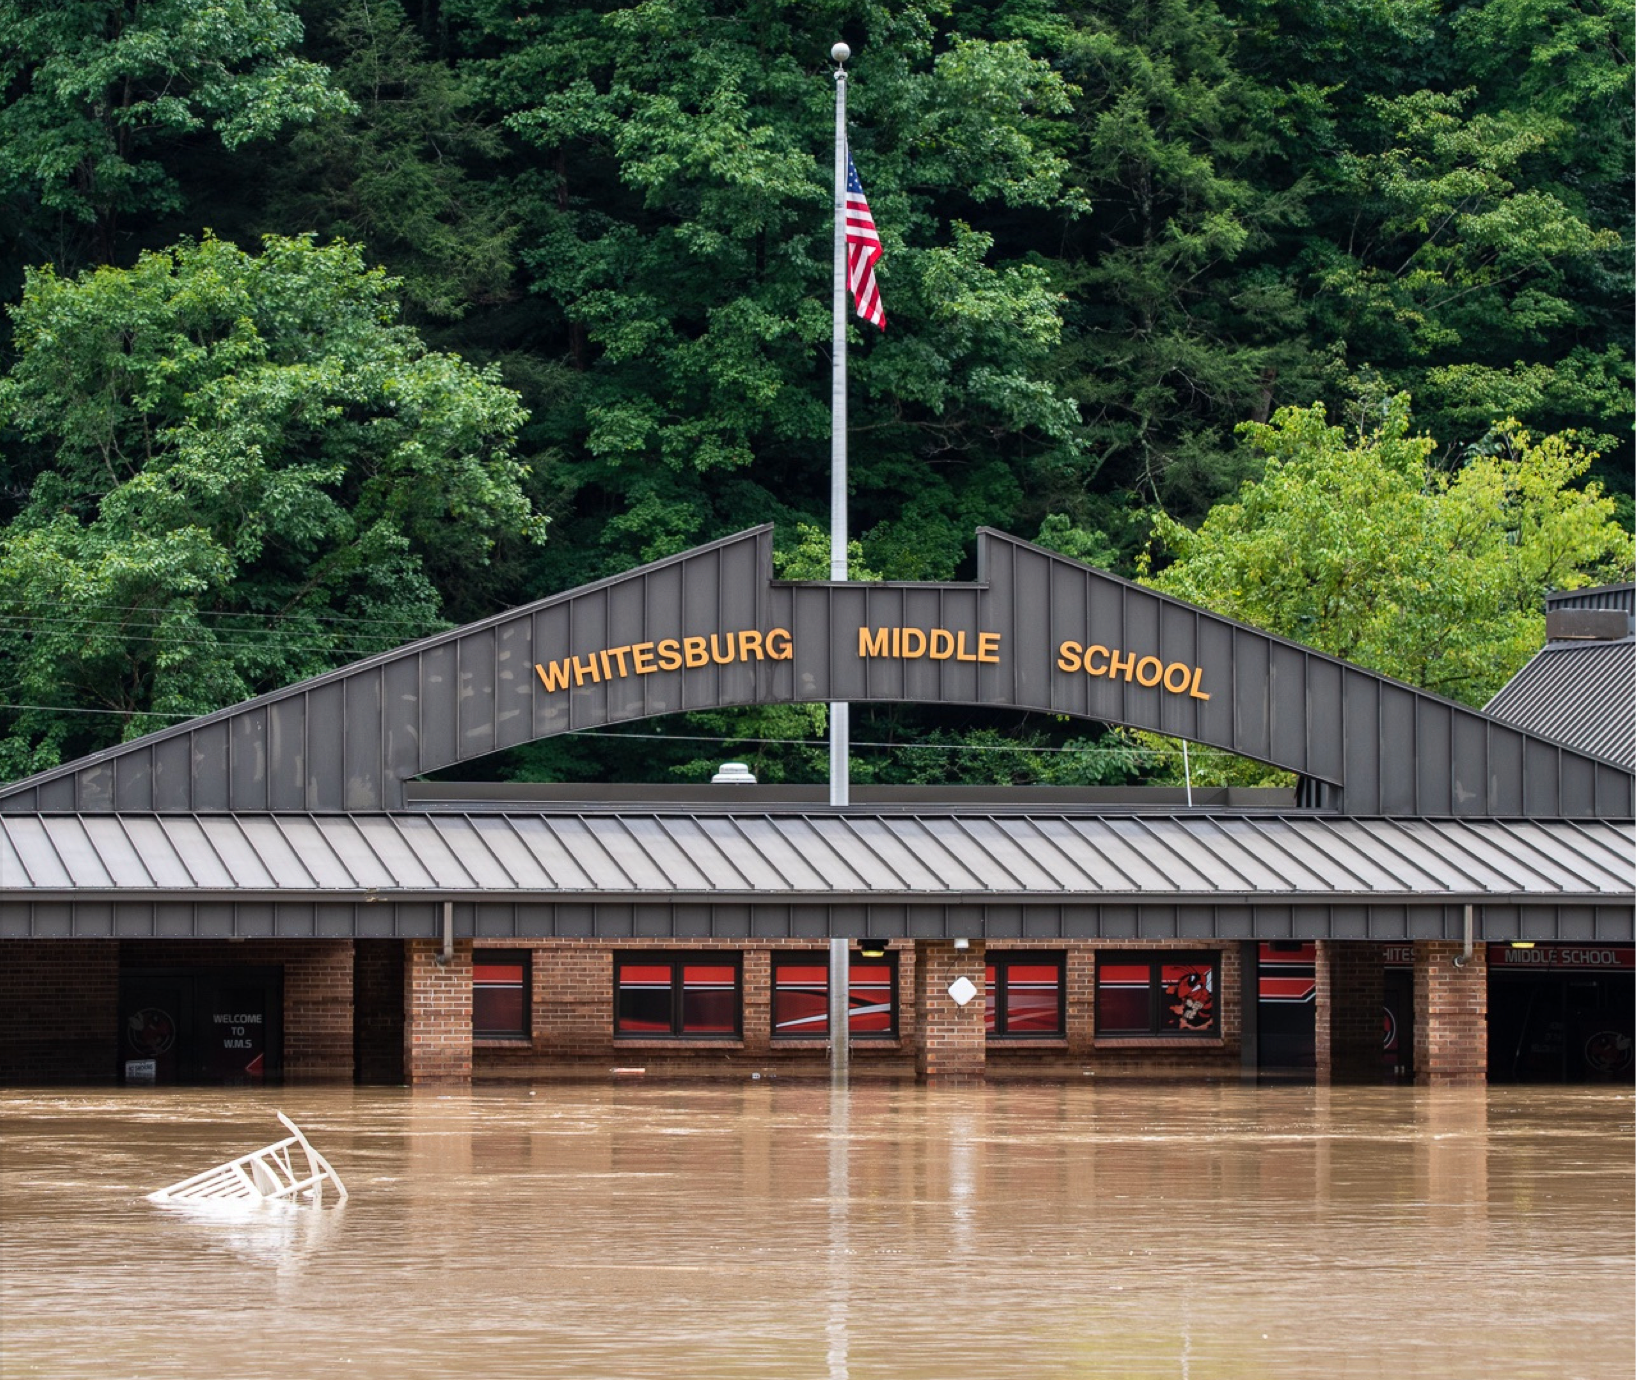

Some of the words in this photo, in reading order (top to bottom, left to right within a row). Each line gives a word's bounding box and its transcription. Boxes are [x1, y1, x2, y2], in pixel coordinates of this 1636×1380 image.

[535, 627, 793, 692] WHITESBURG
[859, 627, 1001, 663] MIDDLE
[1057, 641, 1211, 701] SCHOOL
[1504, 949, 1557, 963] MIDDLE
[1562, 950, 1621, 964] SCHOOL
[213, 1014, 262, 1024] WELCOME
[231, 1026, 245, 1037] TO
